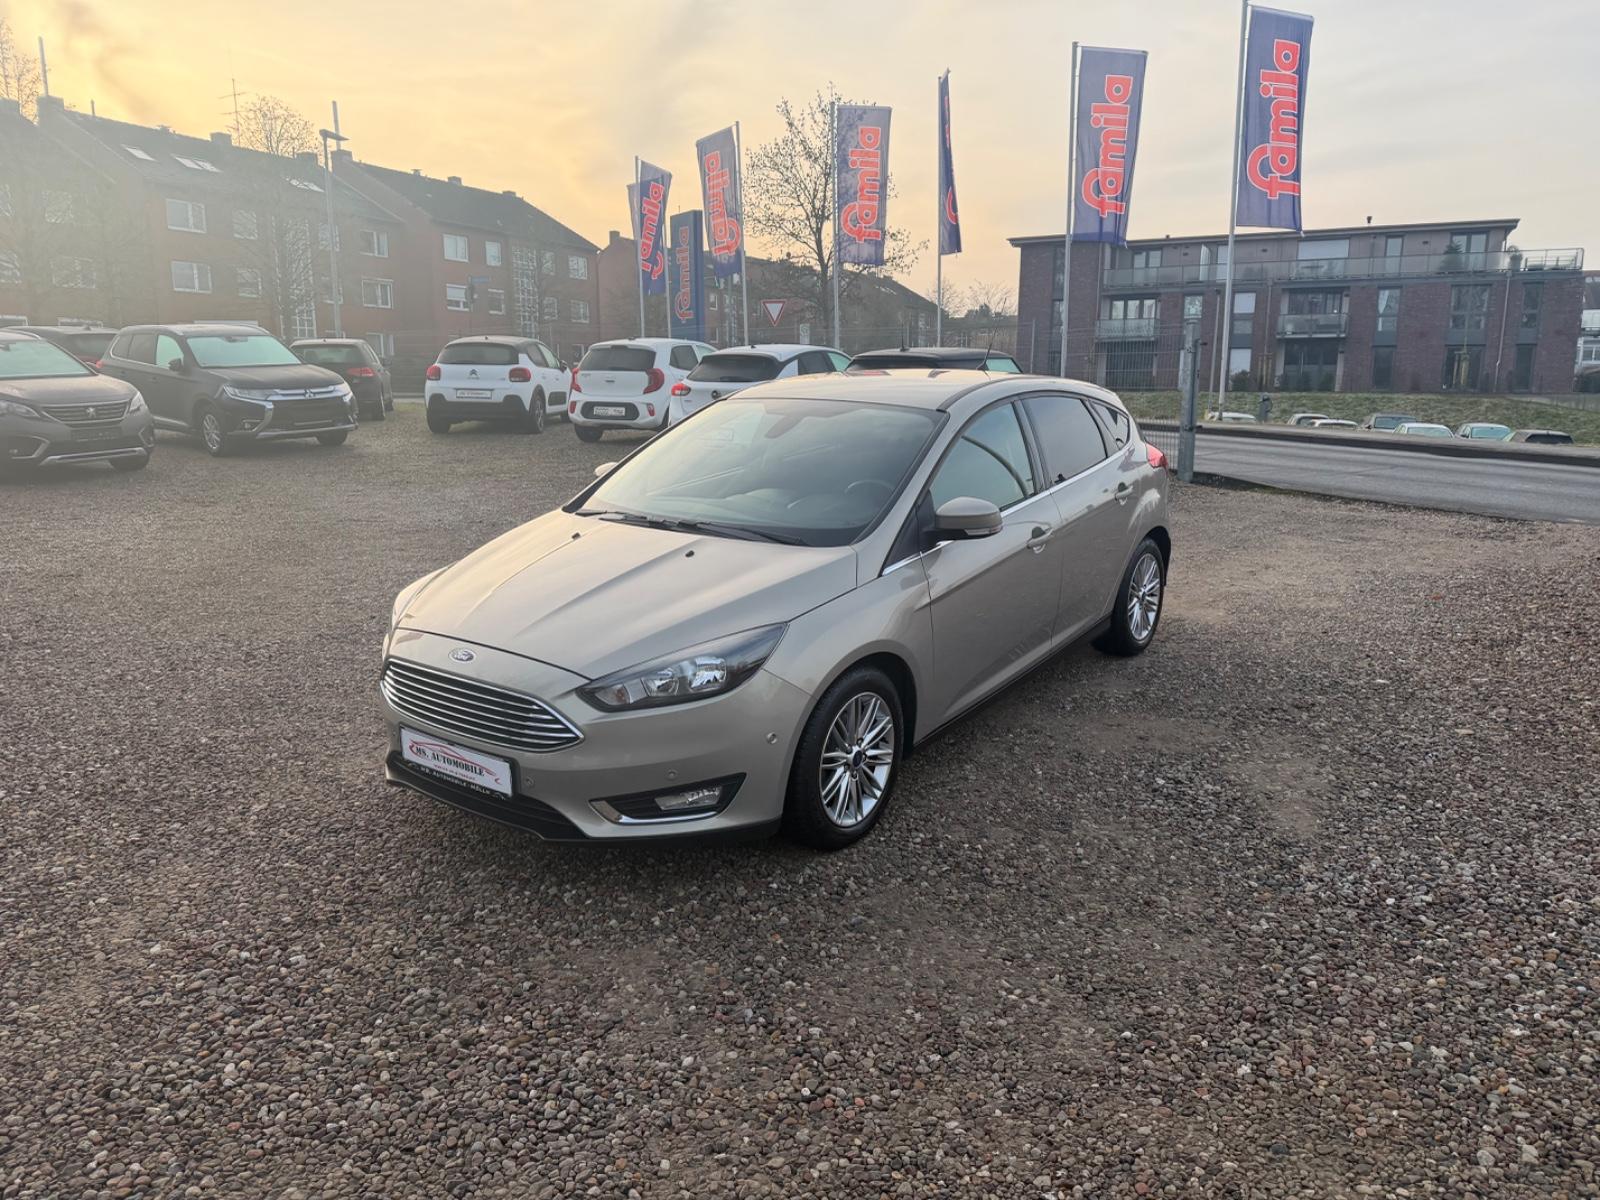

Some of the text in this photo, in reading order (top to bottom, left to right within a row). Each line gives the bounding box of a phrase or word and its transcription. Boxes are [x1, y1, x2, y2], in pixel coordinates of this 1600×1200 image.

[1081, 74, 1134, 218] famila
[1246, 38, 1301, 200] famila
[841, 126, 881, 244] famila
[675, 226, 694, 320] famila
